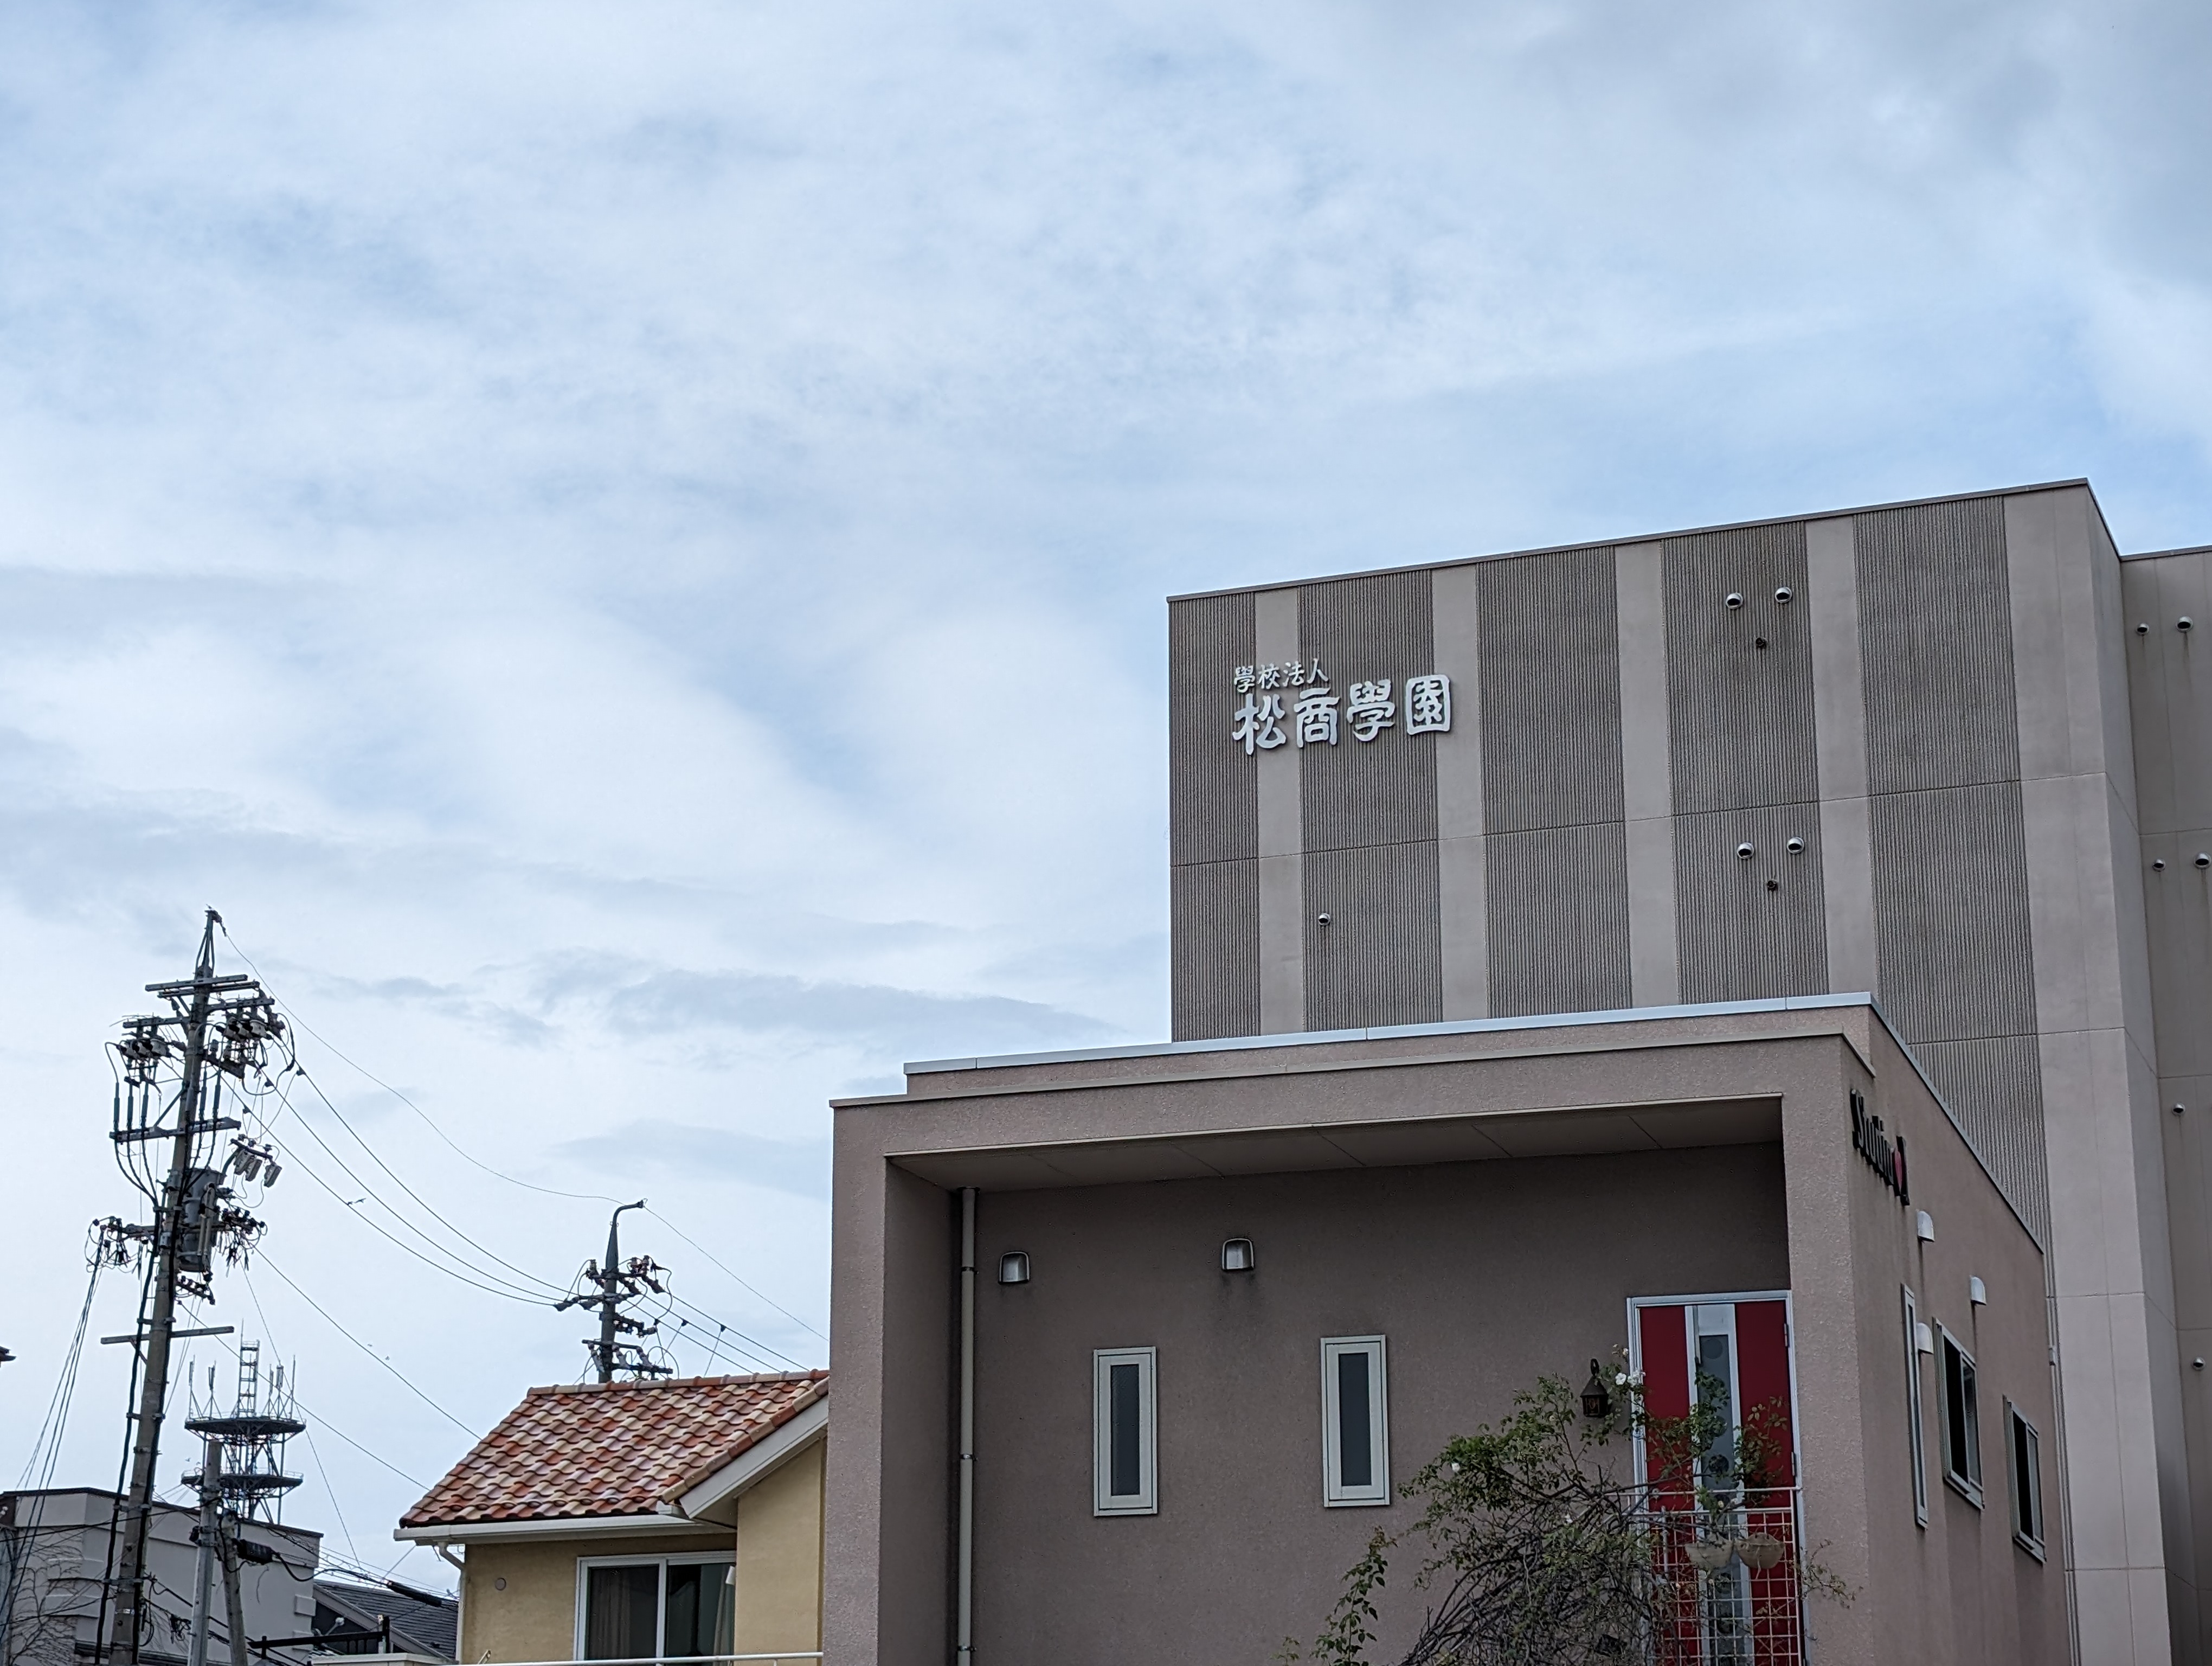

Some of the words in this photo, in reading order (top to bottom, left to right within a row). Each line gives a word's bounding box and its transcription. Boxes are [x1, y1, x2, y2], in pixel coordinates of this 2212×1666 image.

[1233, 658, 1329, 693] 學校法人
[1232, 674, 1451, 755] 松商學園
